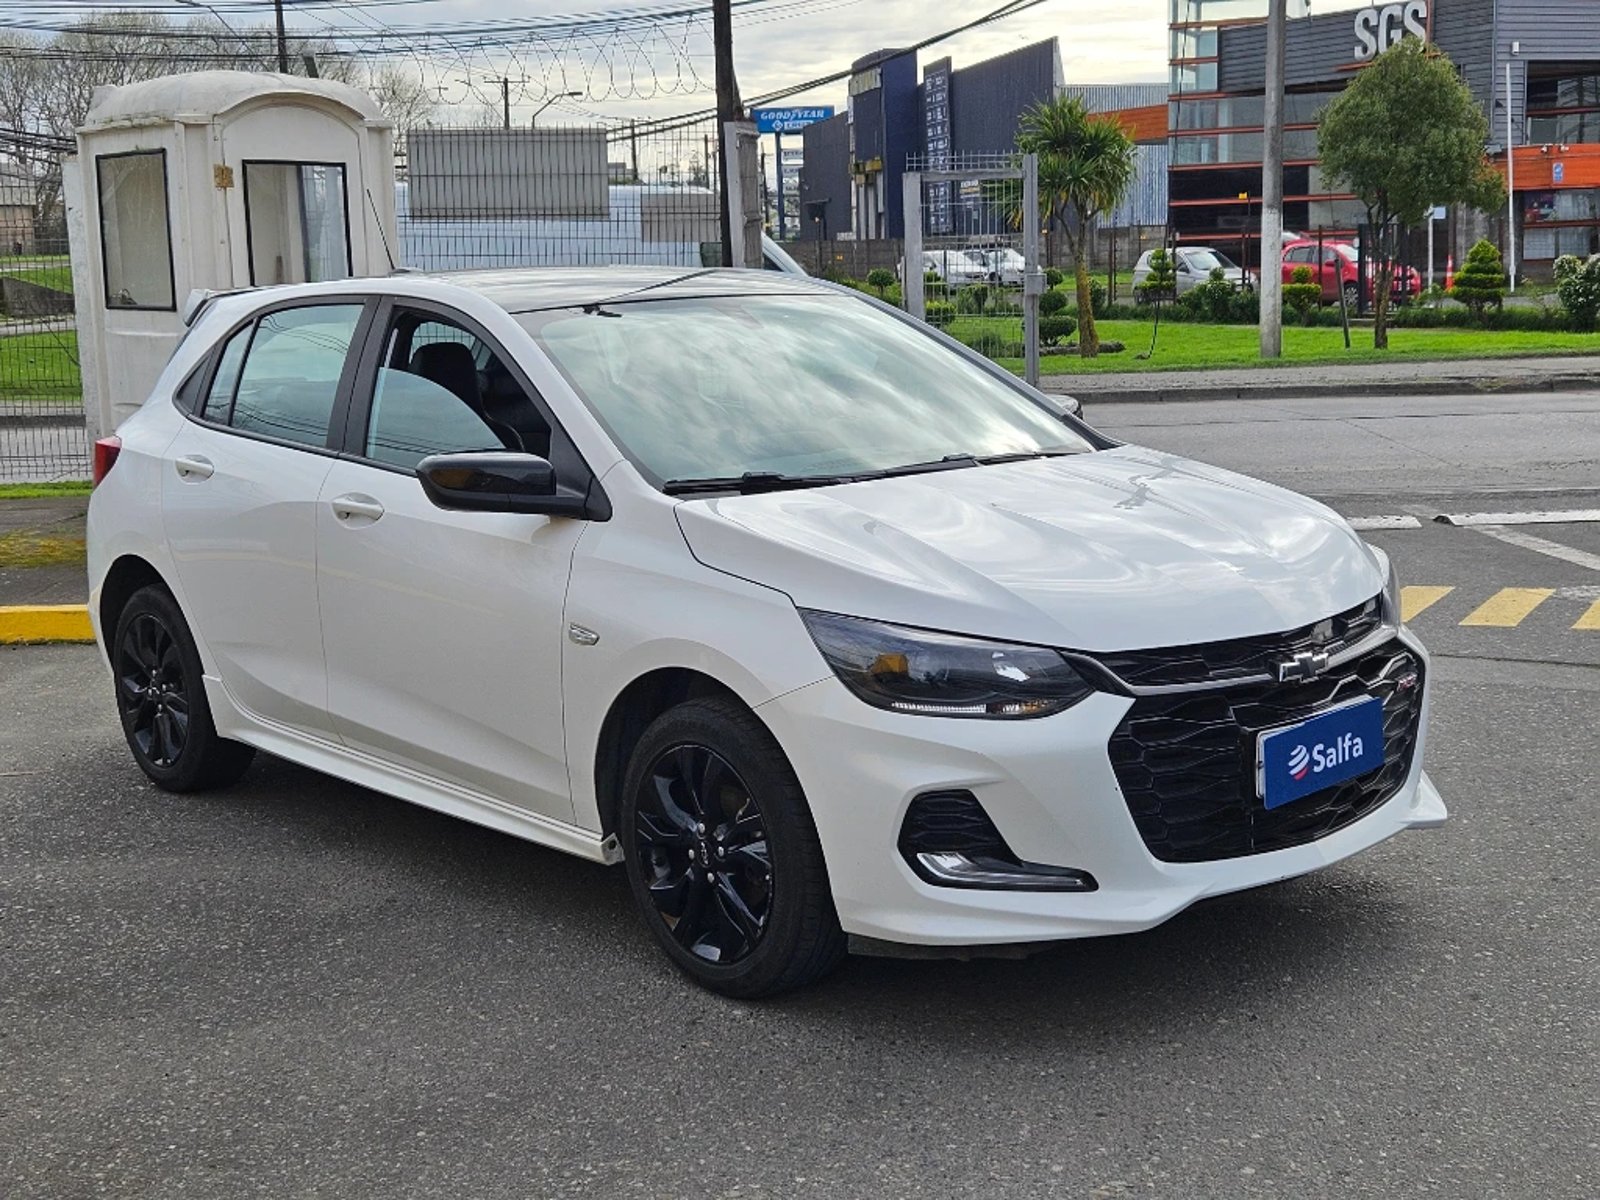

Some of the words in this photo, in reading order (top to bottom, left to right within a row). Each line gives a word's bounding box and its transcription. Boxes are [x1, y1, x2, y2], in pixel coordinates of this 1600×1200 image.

[1354, 1, 1427, 60] SGS
[760, 109, 825, 121] GOODYEAR
[1312, 732, 1363, 772] Salfa
